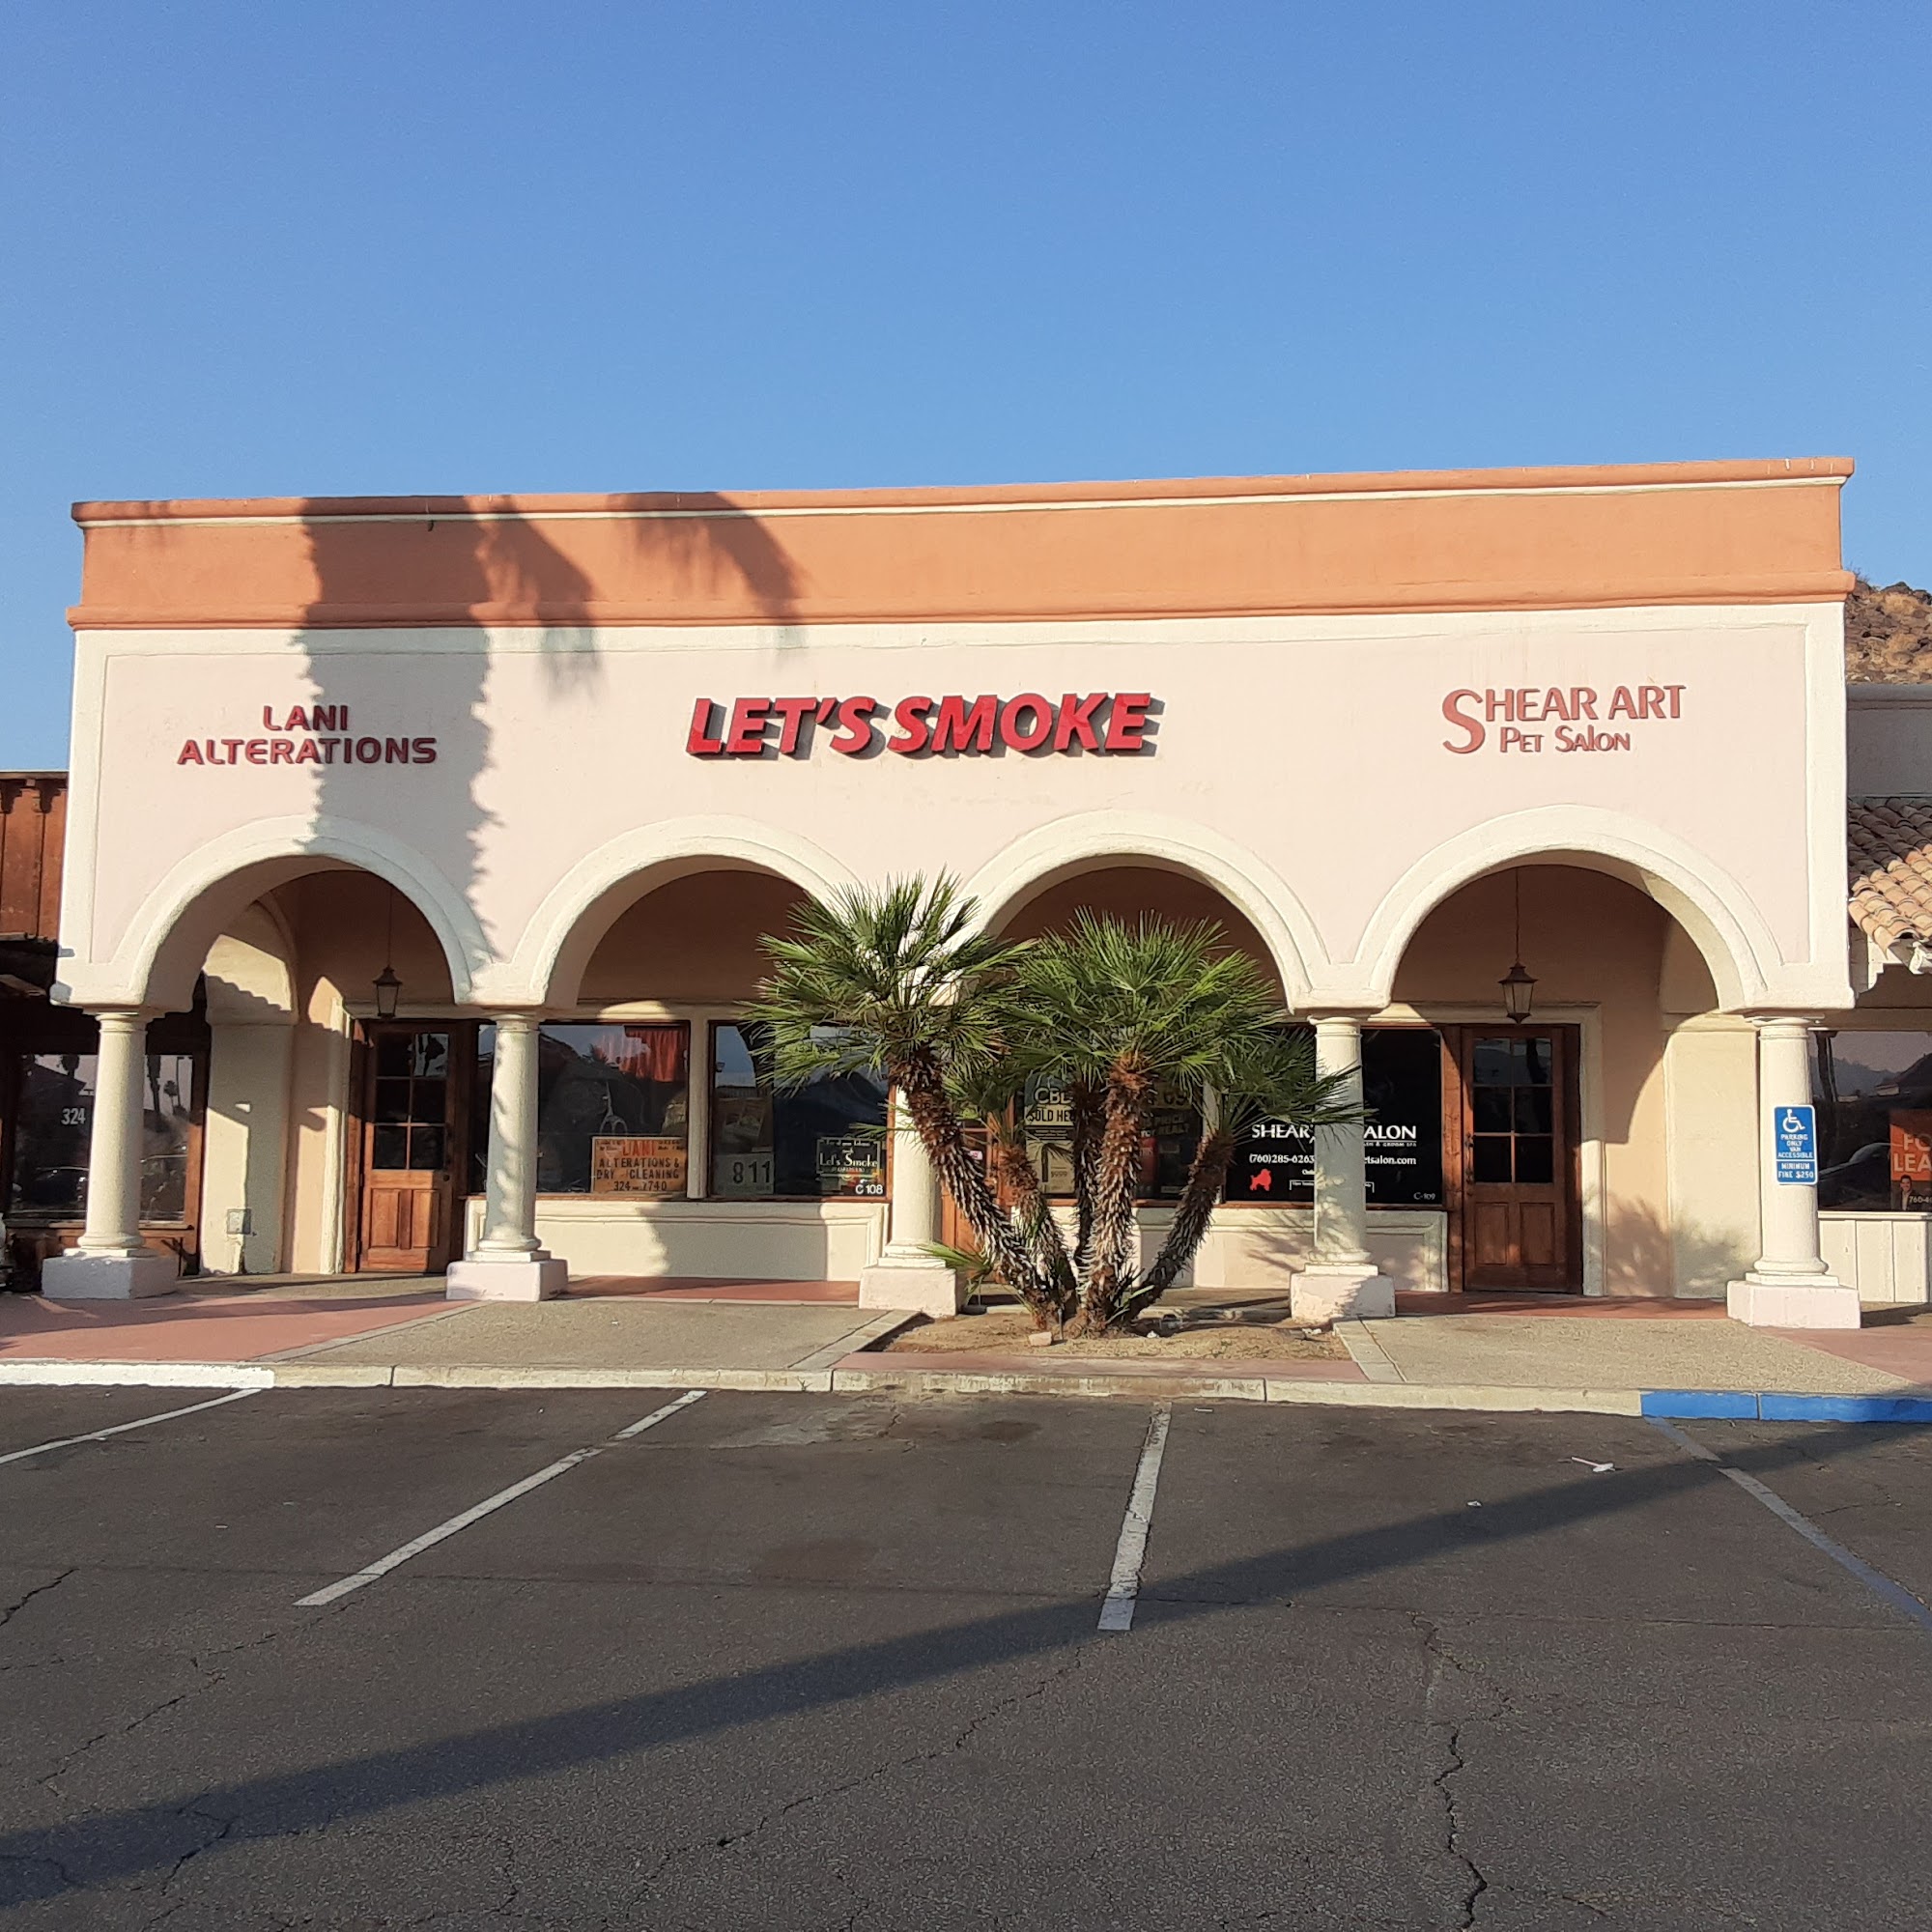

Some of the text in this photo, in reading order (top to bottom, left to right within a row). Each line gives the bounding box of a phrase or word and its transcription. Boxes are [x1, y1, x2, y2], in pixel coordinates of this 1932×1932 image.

[263, 704, 349, 731] LANI
[686, 692, 1152, 754] LET'S SMOKE
[1442, 685, 1687, 754] SHEAR ART
[177, 736, 439, 766] ALTERATIONS
[61, 1108, 86, 1125] 324
[1025, 1110, 1053, 1122] OLD
[1252, 1124, 1310, 1139] SHEAR
[599, 1157, 671, 1169] ALTERATIONS
[820, 1152, 878, 1167] Let's Smoke
[596, 1169, 680, 1179] DRY CLEANING
[733, 1161, 770, 1183] 811
[866, 1184, 883, 1195] 108
